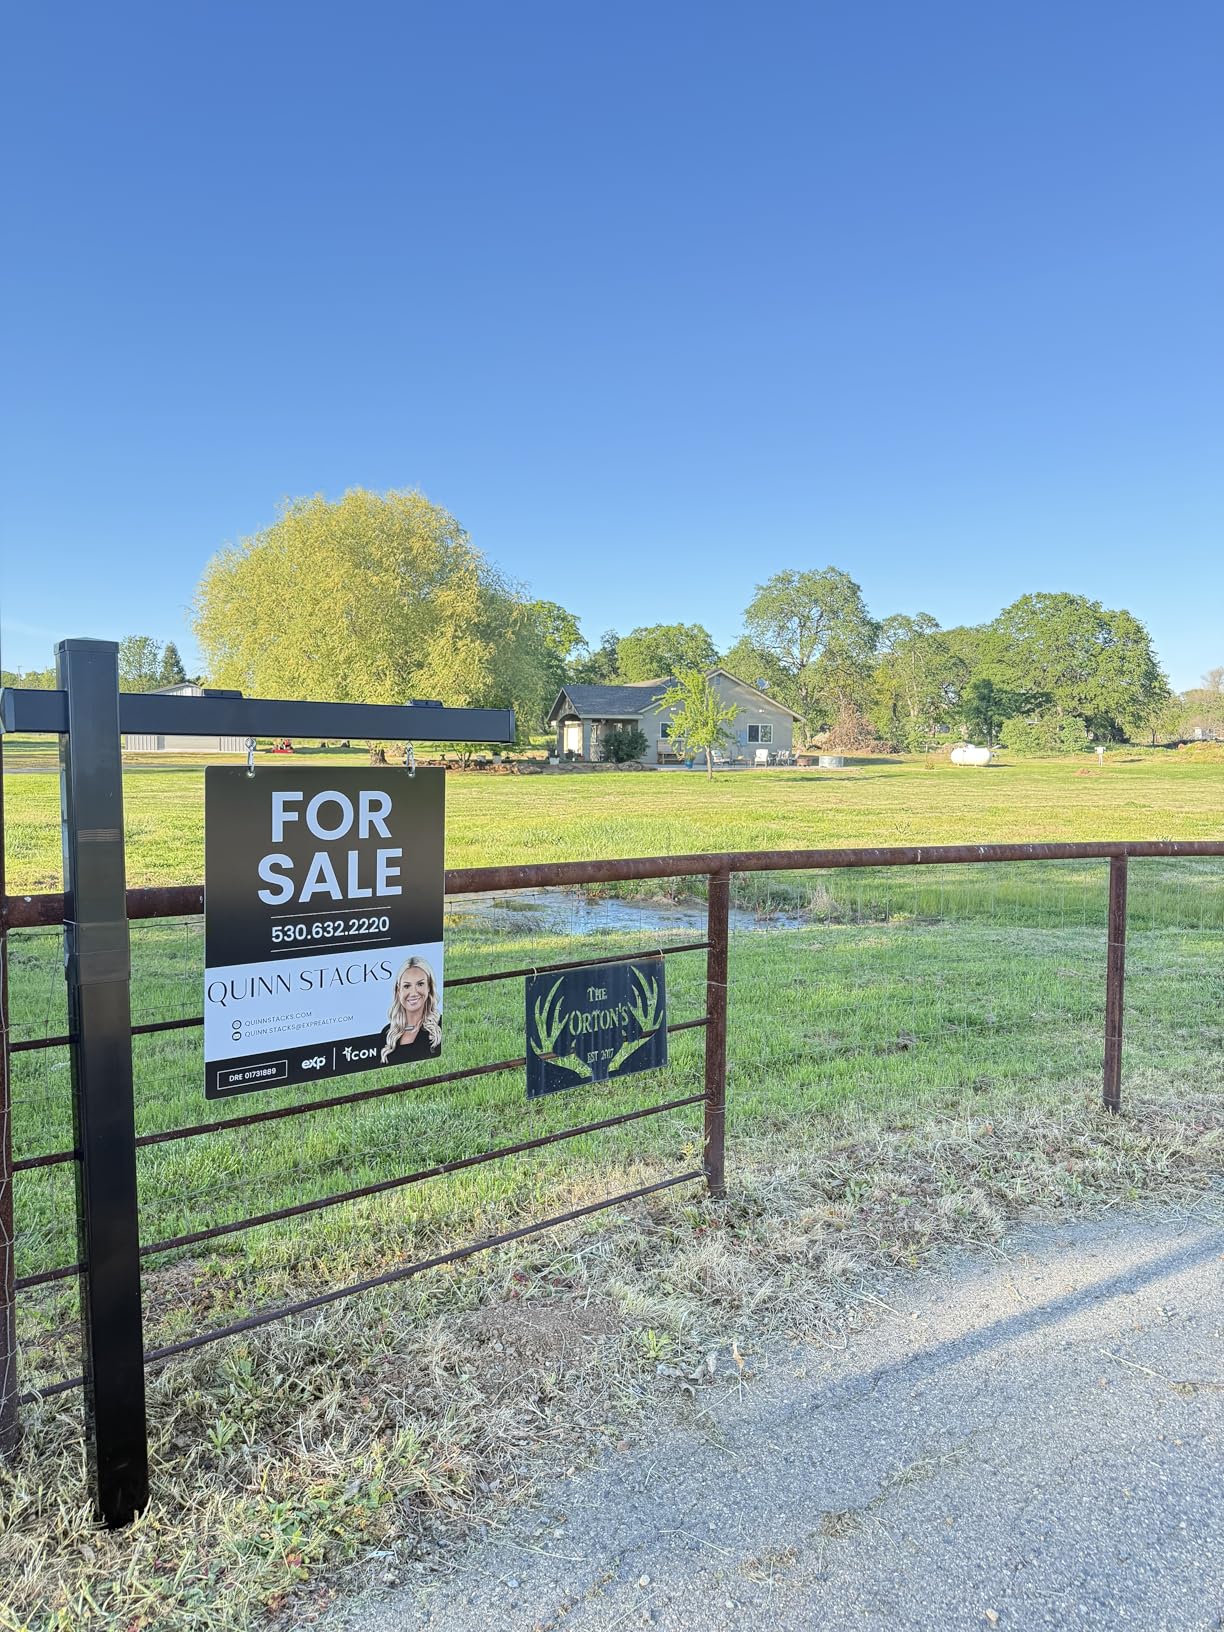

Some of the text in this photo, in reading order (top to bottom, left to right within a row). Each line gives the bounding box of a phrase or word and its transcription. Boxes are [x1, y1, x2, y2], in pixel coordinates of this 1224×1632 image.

[271, 790, 393, 843] FOR
[257, 847, 403, 906] SALE
[271, 916, 390, 943] 530.632.2220
[207, 960, 393, 1008] QUINN STACKS
[587, 986, 608, 1002] THE
[244, 1016, 354, 1038] QUINNSTACKS@EXPREALTYCOM
[228, 1074, 243, 1083] DRE
